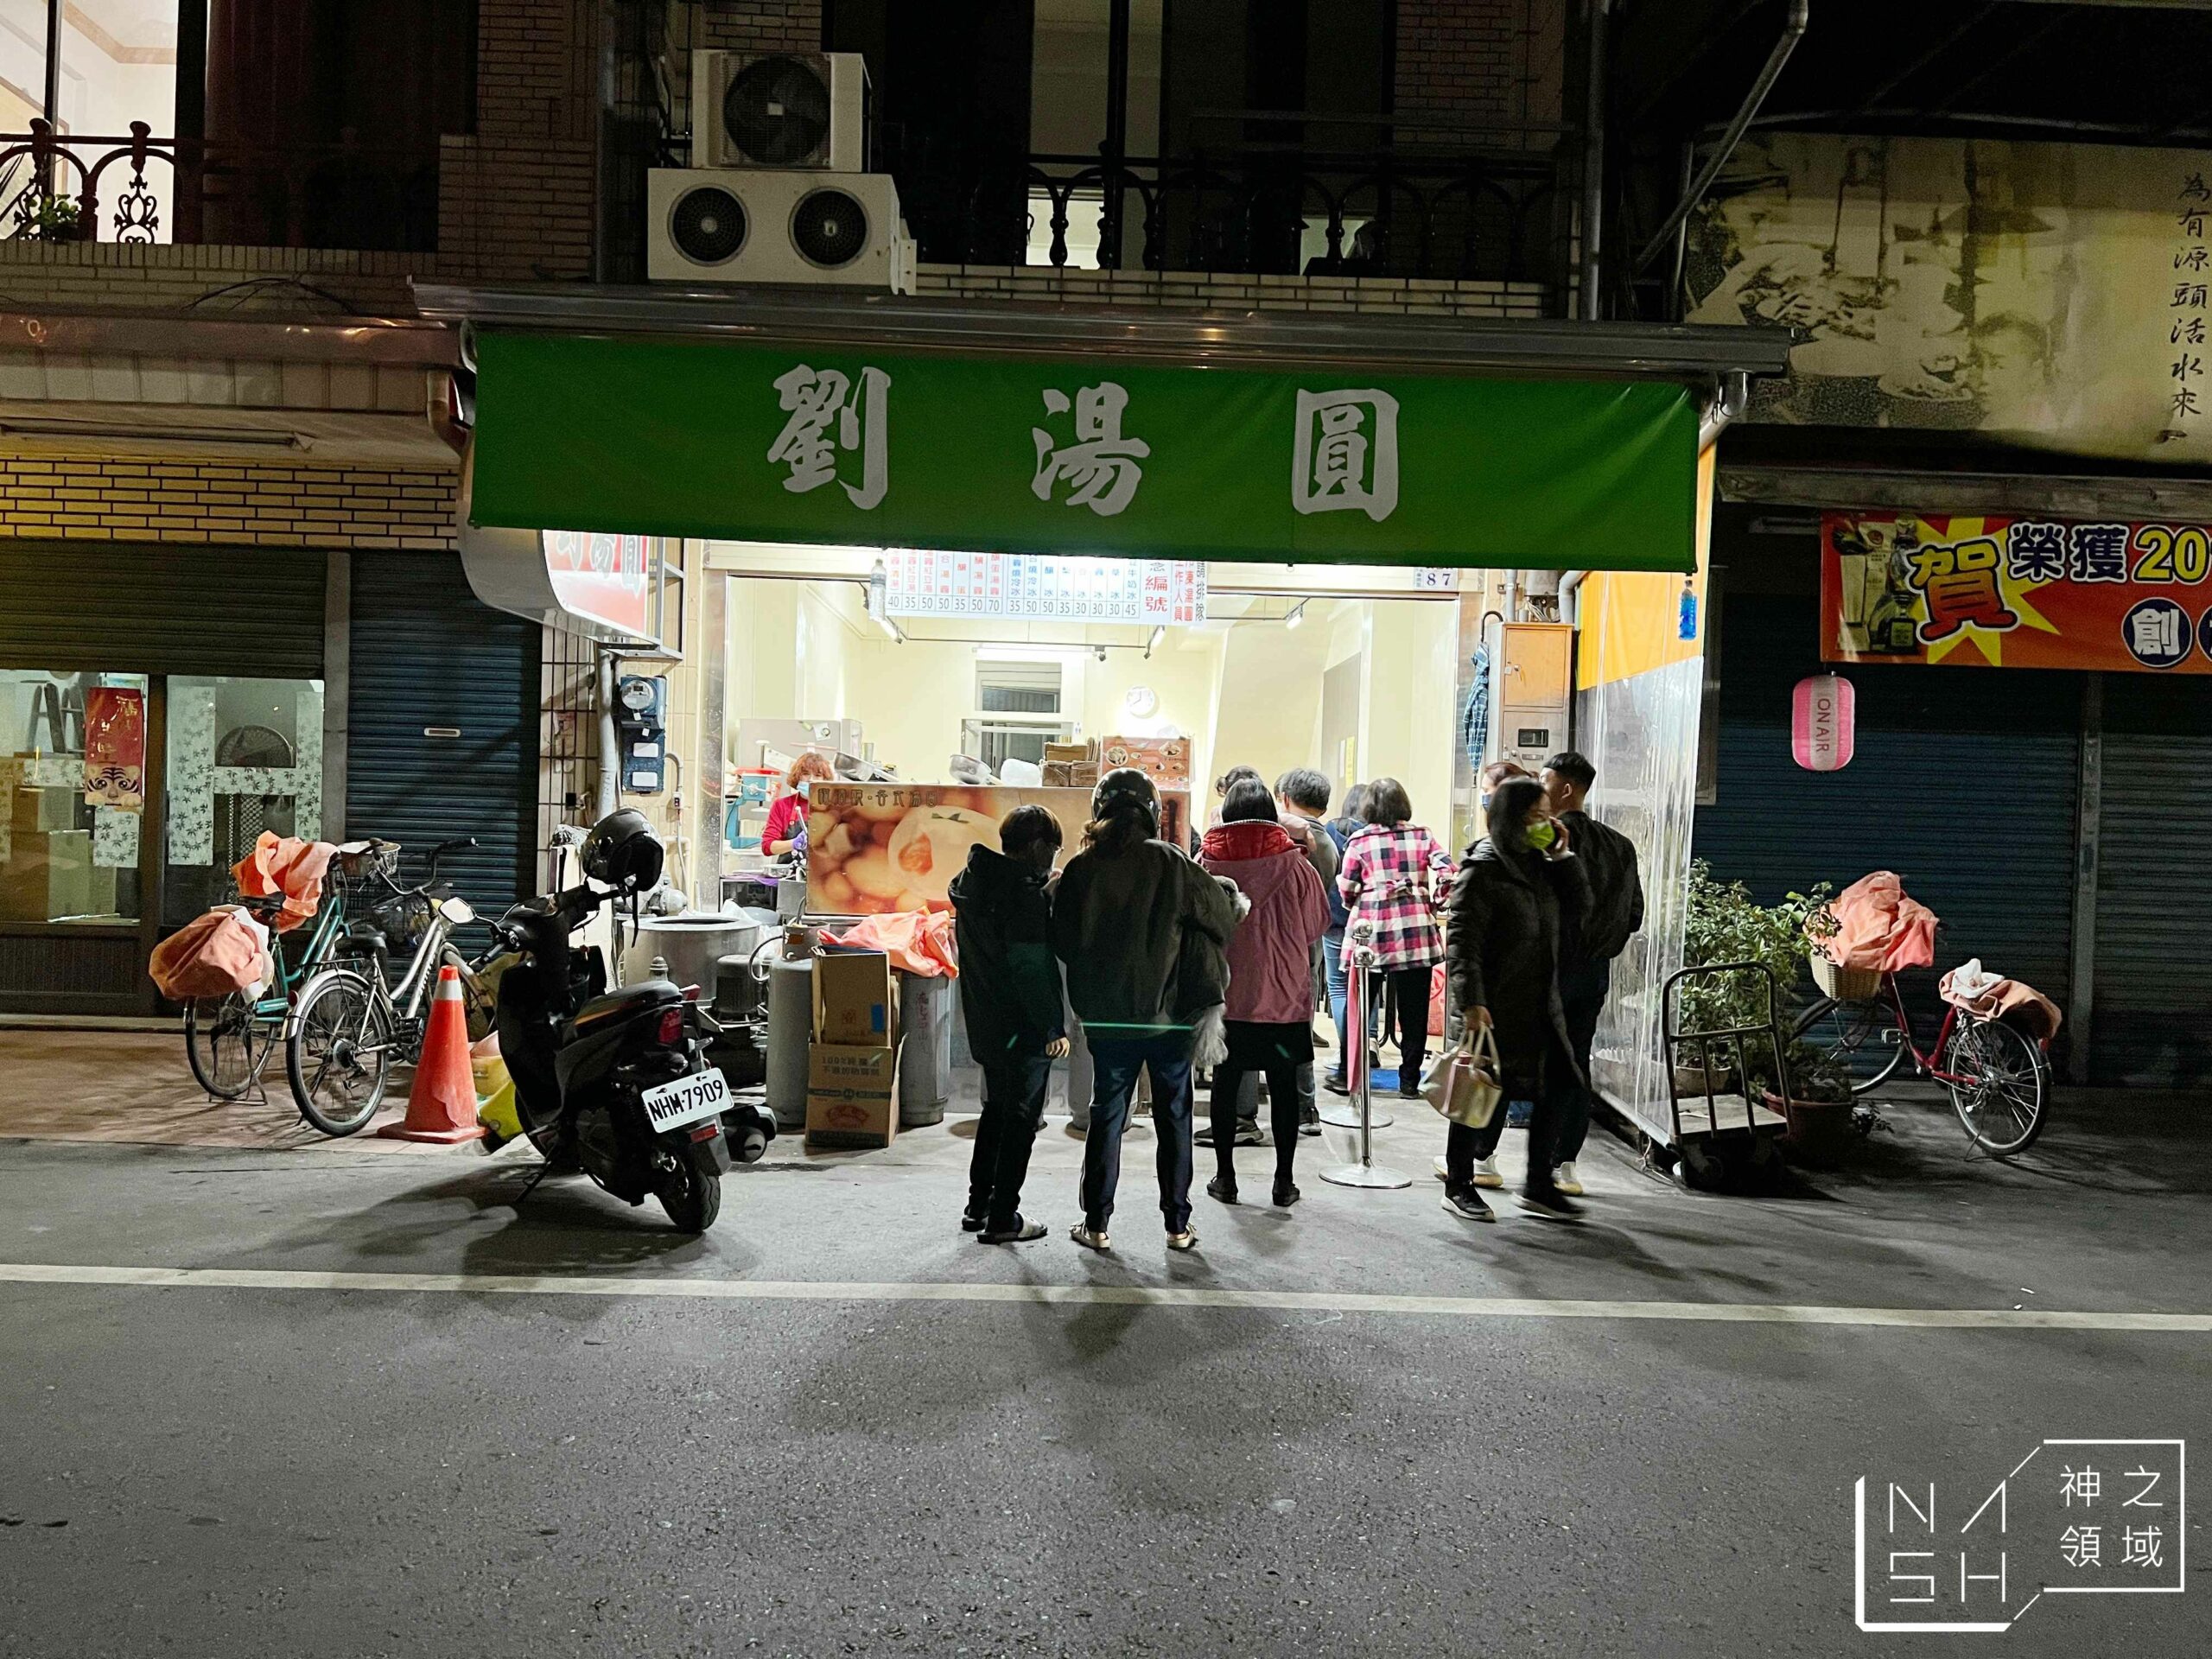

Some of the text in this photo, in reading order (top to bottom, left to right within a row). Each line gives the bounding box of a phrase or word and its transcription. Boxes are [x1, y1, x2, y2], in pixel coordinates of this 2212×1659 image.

[2170, 173, 2211, 418] 為有源頭活水來
[767, 363, 1401, 523] 劉湯圓
[1907, 536, 2022, 643] 賀
[888, 596, 899, 607] 40
[905, 597, 916, 608] 35
[922, 597, 933, 609] 50
[938, 598, 950, 609] 50
[955, 599, 966, 610] 35
[972, 599, 982, 611] 50
[988, 600, 1000, 612] 70
[1009, 601, 1020, 612] 35
[1026, 601, 1037, 613] 50
[1043, 601, 1053, 613] 50
[1059, 602, 1070, 613] 35
[1076, 602, 1086, 613] 30
[1091, 603, 1103, 614] 30
[1109, 603, 1120, 615] 30
[1125, 604, 1136, 616] 45
[2132, 607, 2180, 657] 創
[1815, 698, 1831, 753] ON AIR
[648, 1079, 724, 1122] NHM-7909
